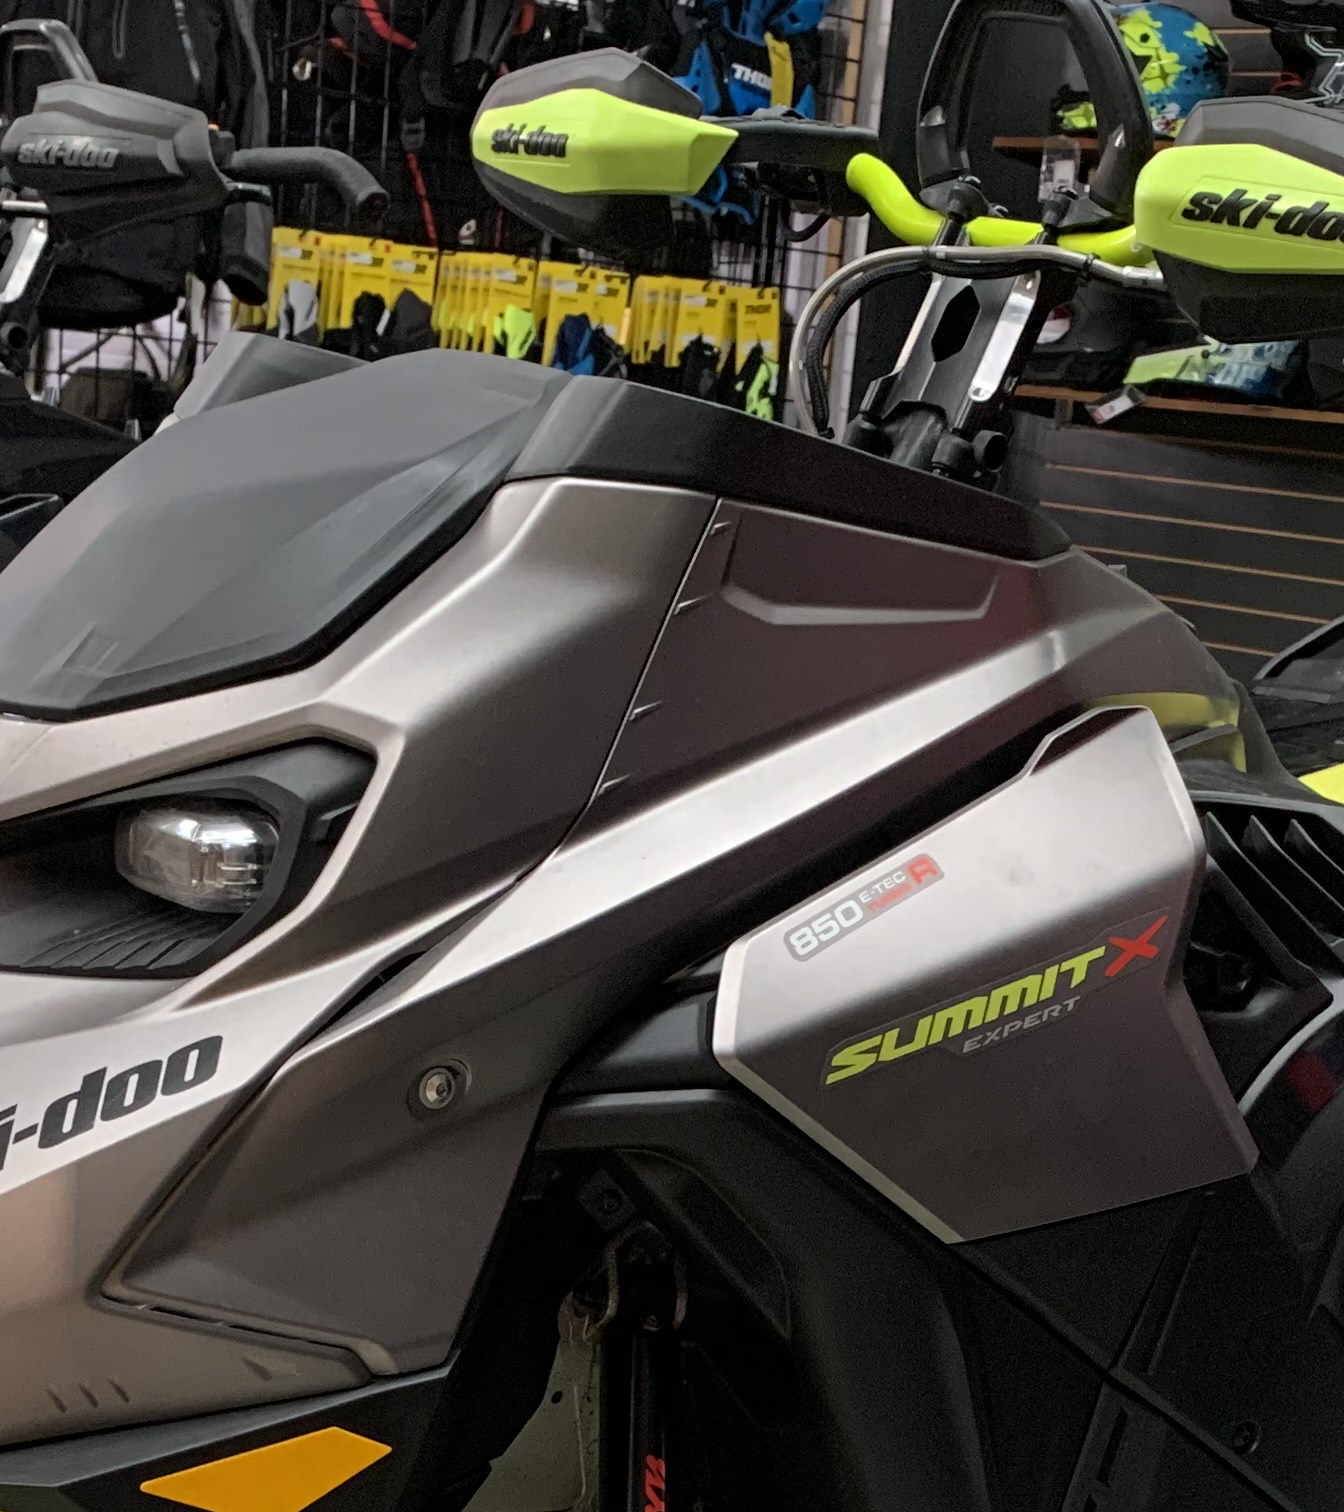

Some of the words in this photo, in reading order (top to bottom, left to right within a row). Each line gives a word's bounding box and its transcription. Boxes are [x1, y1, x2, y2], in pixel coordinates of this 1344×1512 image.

[731, 63, 773, 90] THO
[18, 138, 119, 168] ski-doo
[492, 122, 569, 158] ski-doo
[789, 899, 864, 956] 850
[858, 870, 906, 904] E-TEC
[907, 856, 939, 885] R
[825, 945, 1106, 1085] SUMMIT
[1104, 915, 1169, 977] X
[962, 995, 1082, 1054] EXPERT
